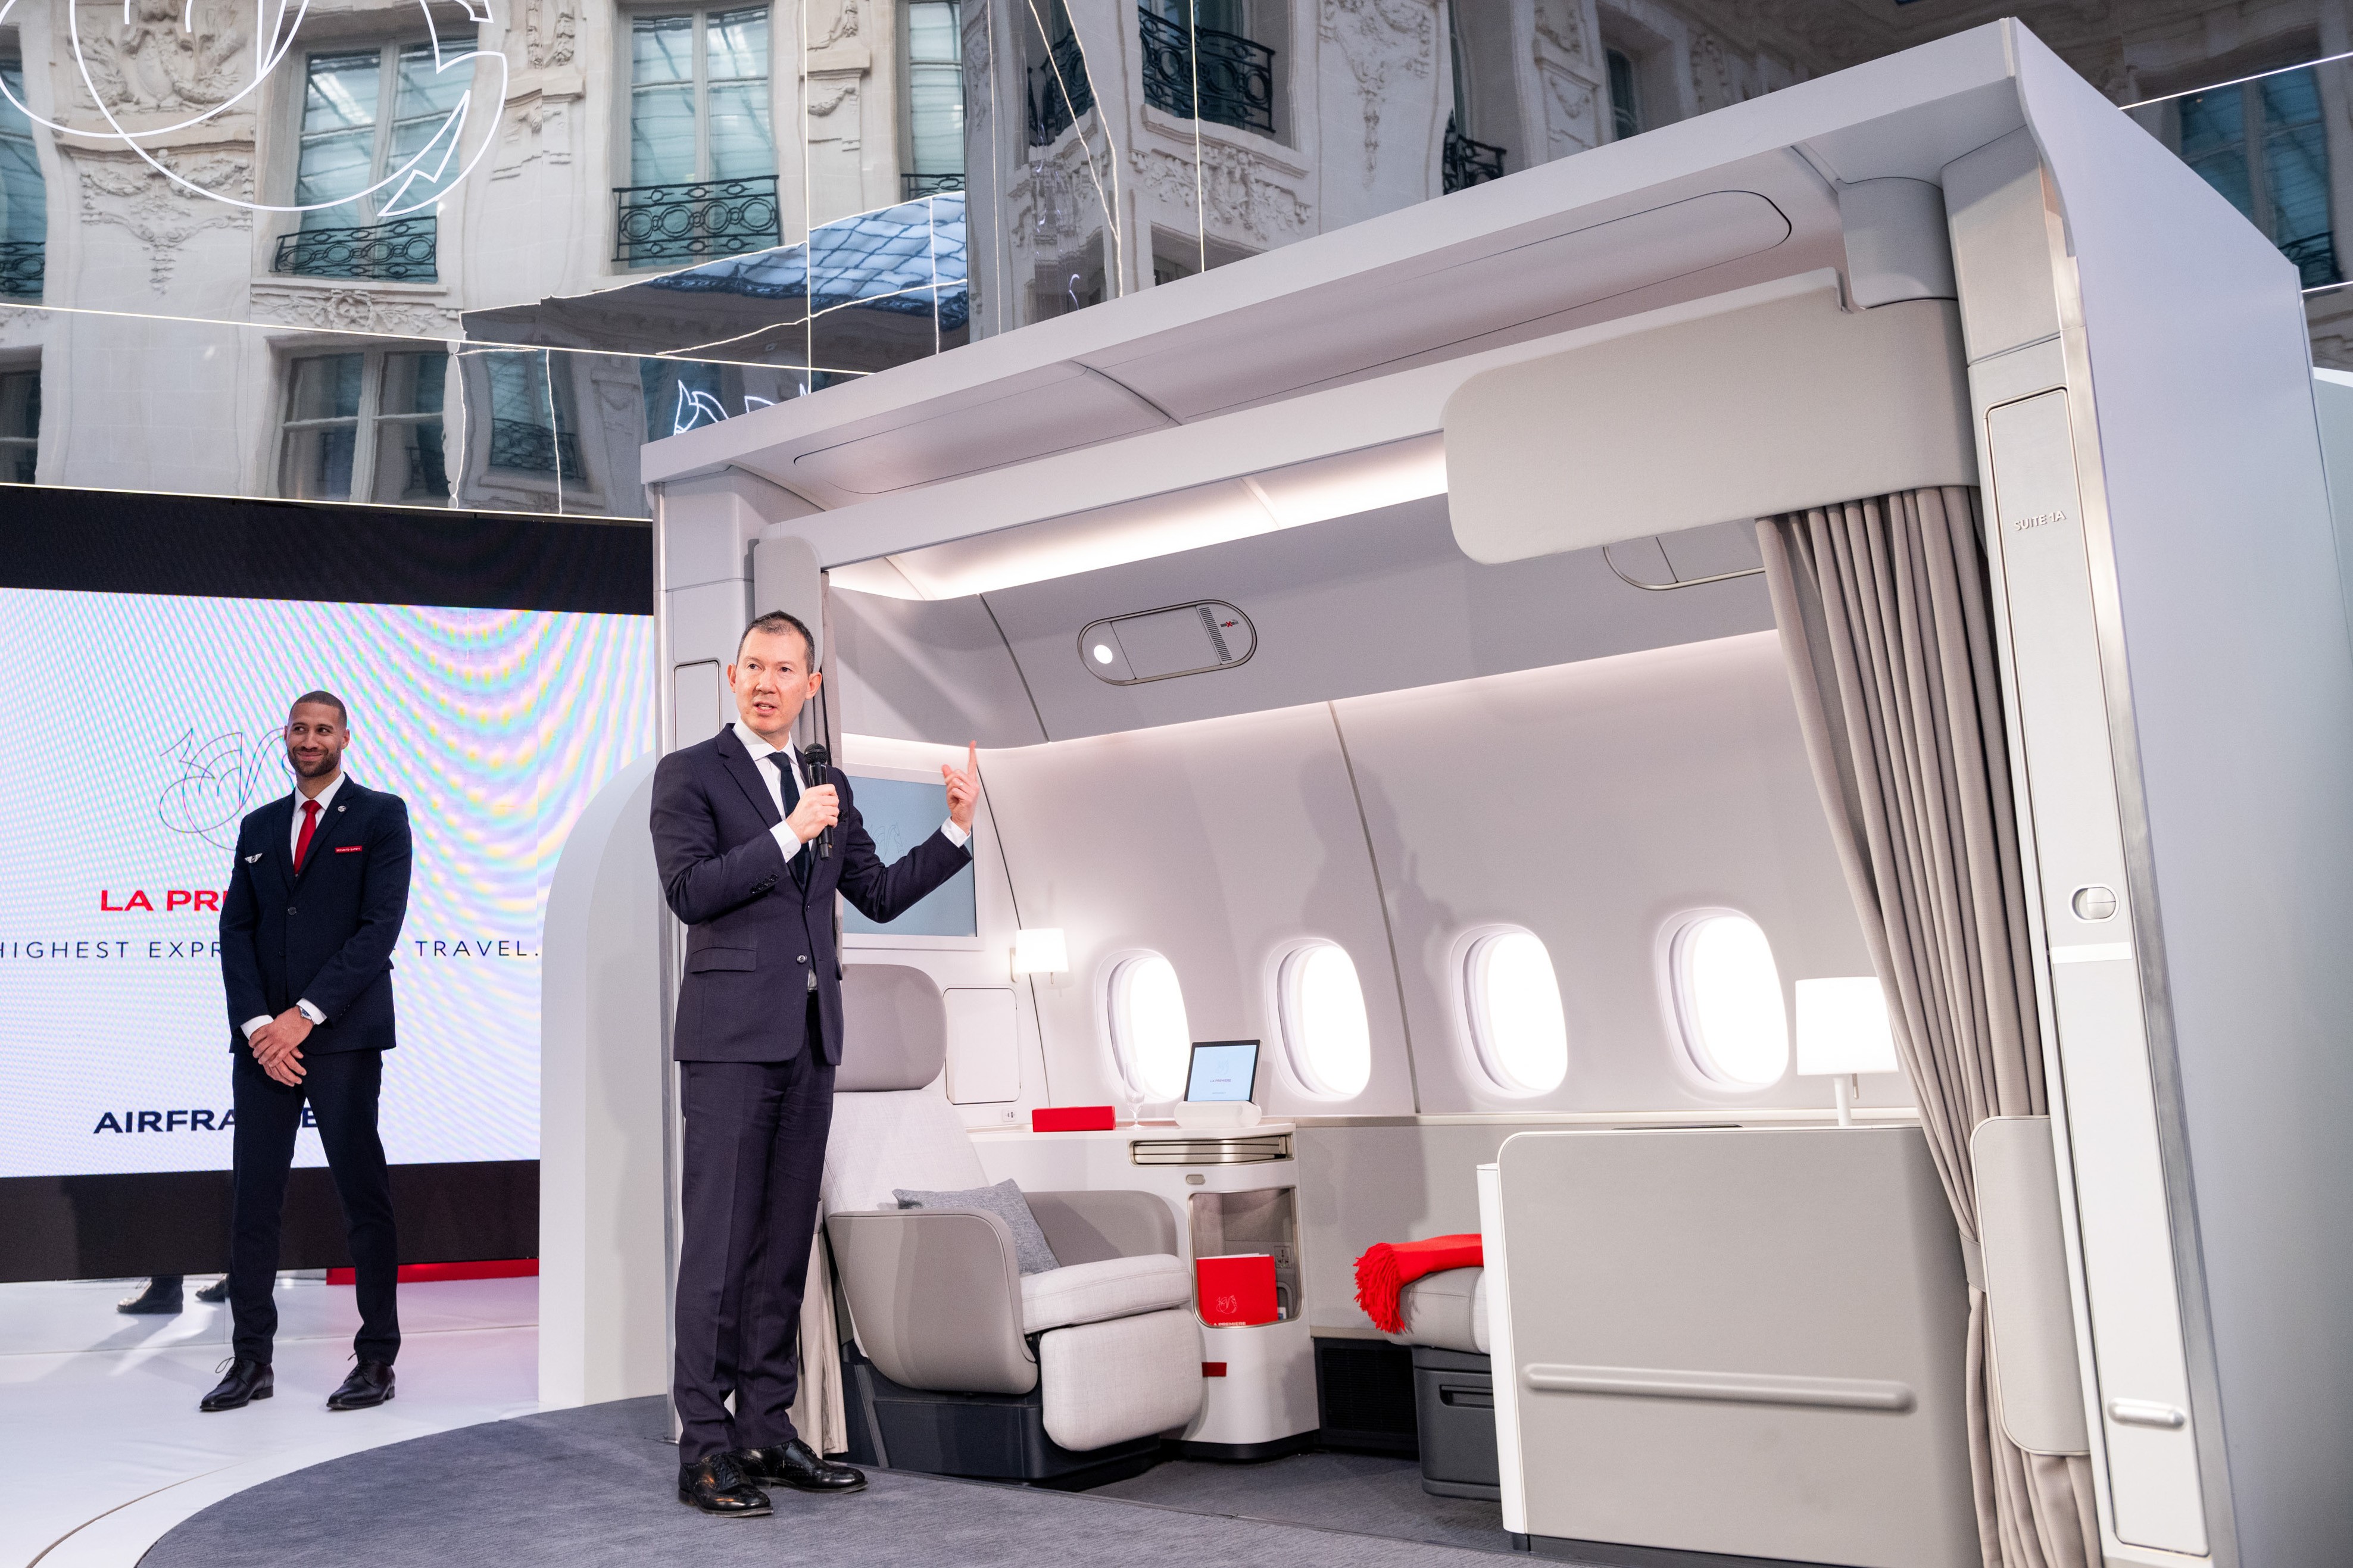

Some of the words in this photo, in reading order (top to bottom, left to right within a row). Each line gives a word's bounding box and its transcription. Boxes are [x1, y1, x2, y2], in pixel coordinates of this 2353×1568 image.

[2014, 513, 2048, 531] SUITE
[2048, 510, 2067, 522] 1A
[101, 889, 154, 911] LA
[167, 890, 229, 911] PR
[415, 941, 538, 957] TRAVEL.
